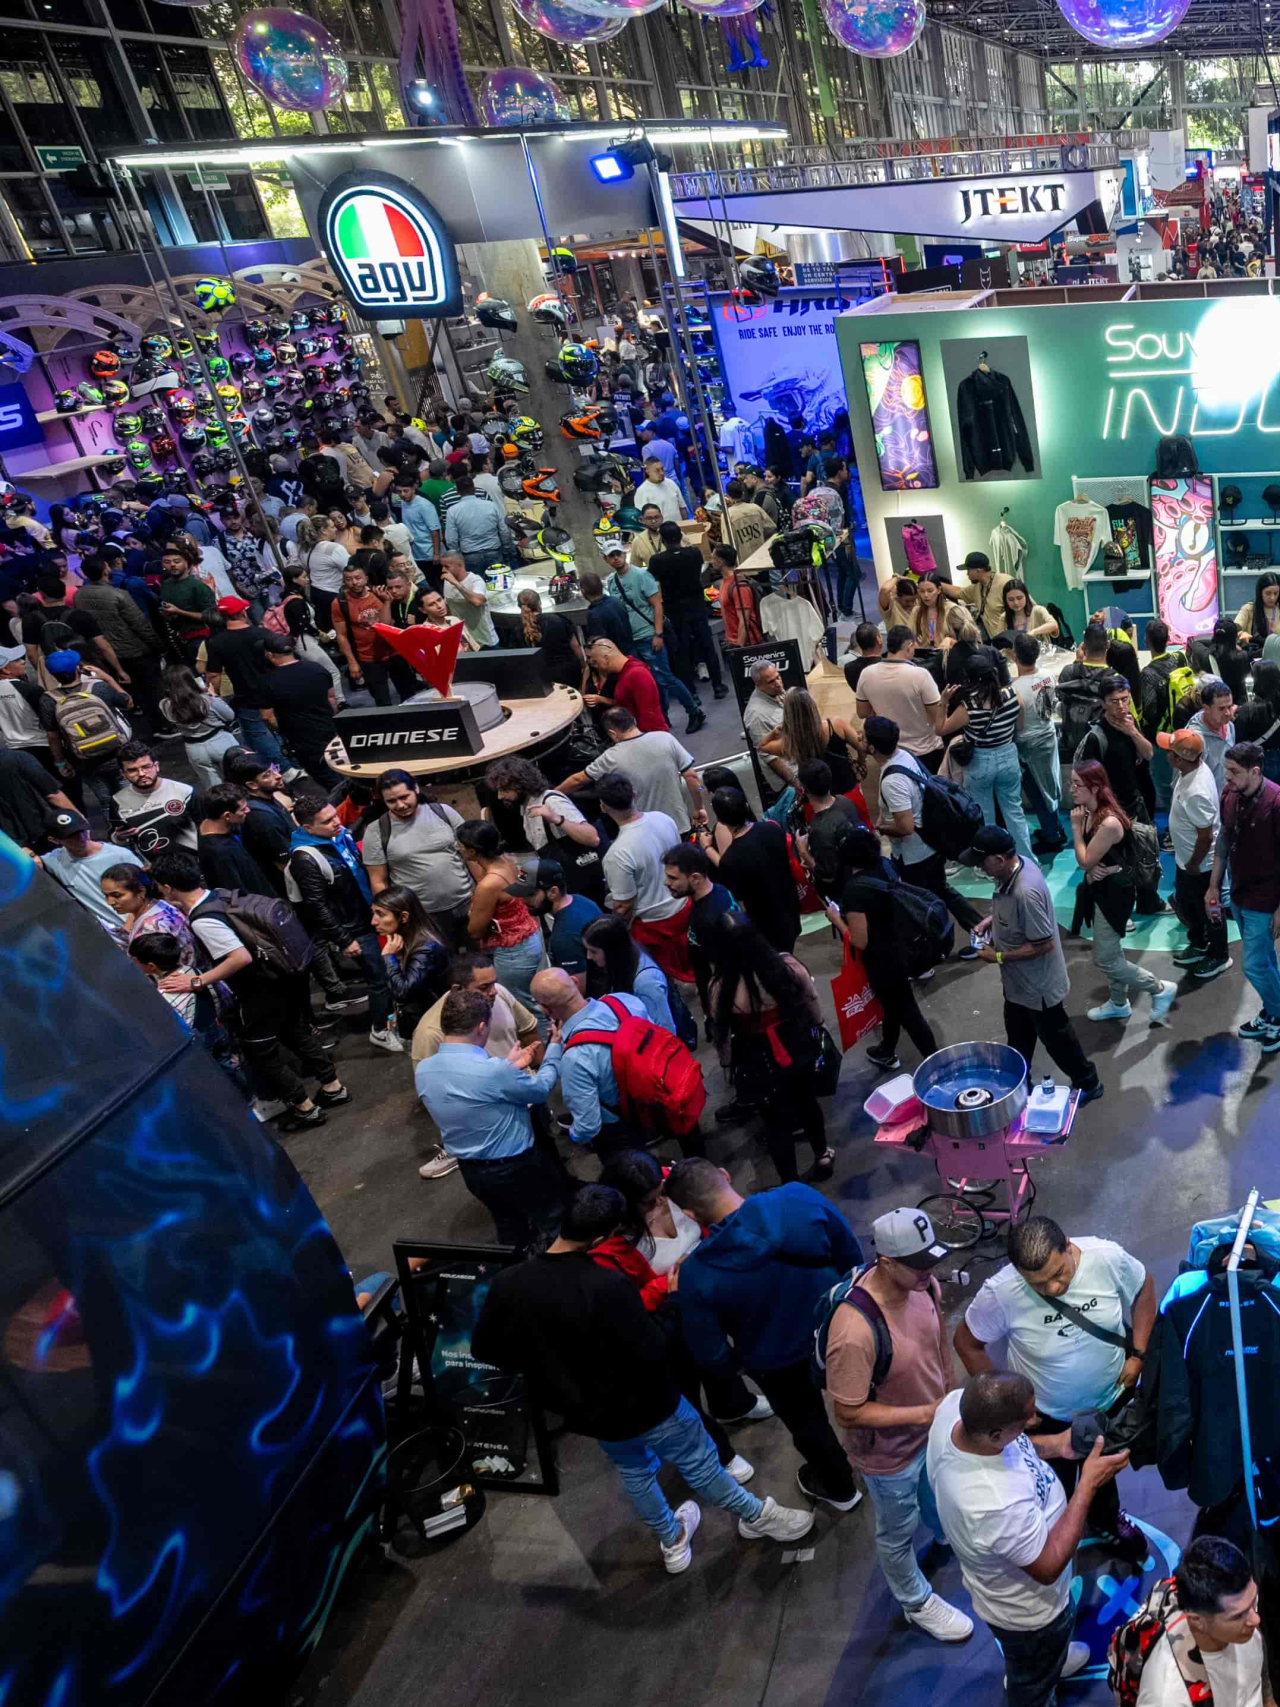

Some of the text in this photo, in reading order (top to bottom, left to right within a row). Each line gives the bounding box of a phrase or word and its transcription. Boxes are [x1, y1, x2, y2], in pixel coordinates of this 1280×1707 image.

[960, 183, 1066, 223] JTEKT
[357, 262, 427, 302] agv
[738, 323, 835, 340] RIDE SAFE ENJOY THE RO
[742, 650, 787, 664] Souvenirs
[349, 727, 459, 748] DAINESE
[913, 1215, 928, 1243] P
[1043, 1297, 1098, 1325] BADOG
[441, 1350, 458, 1358] Nos
[445, 1359, 463, 1368] para
